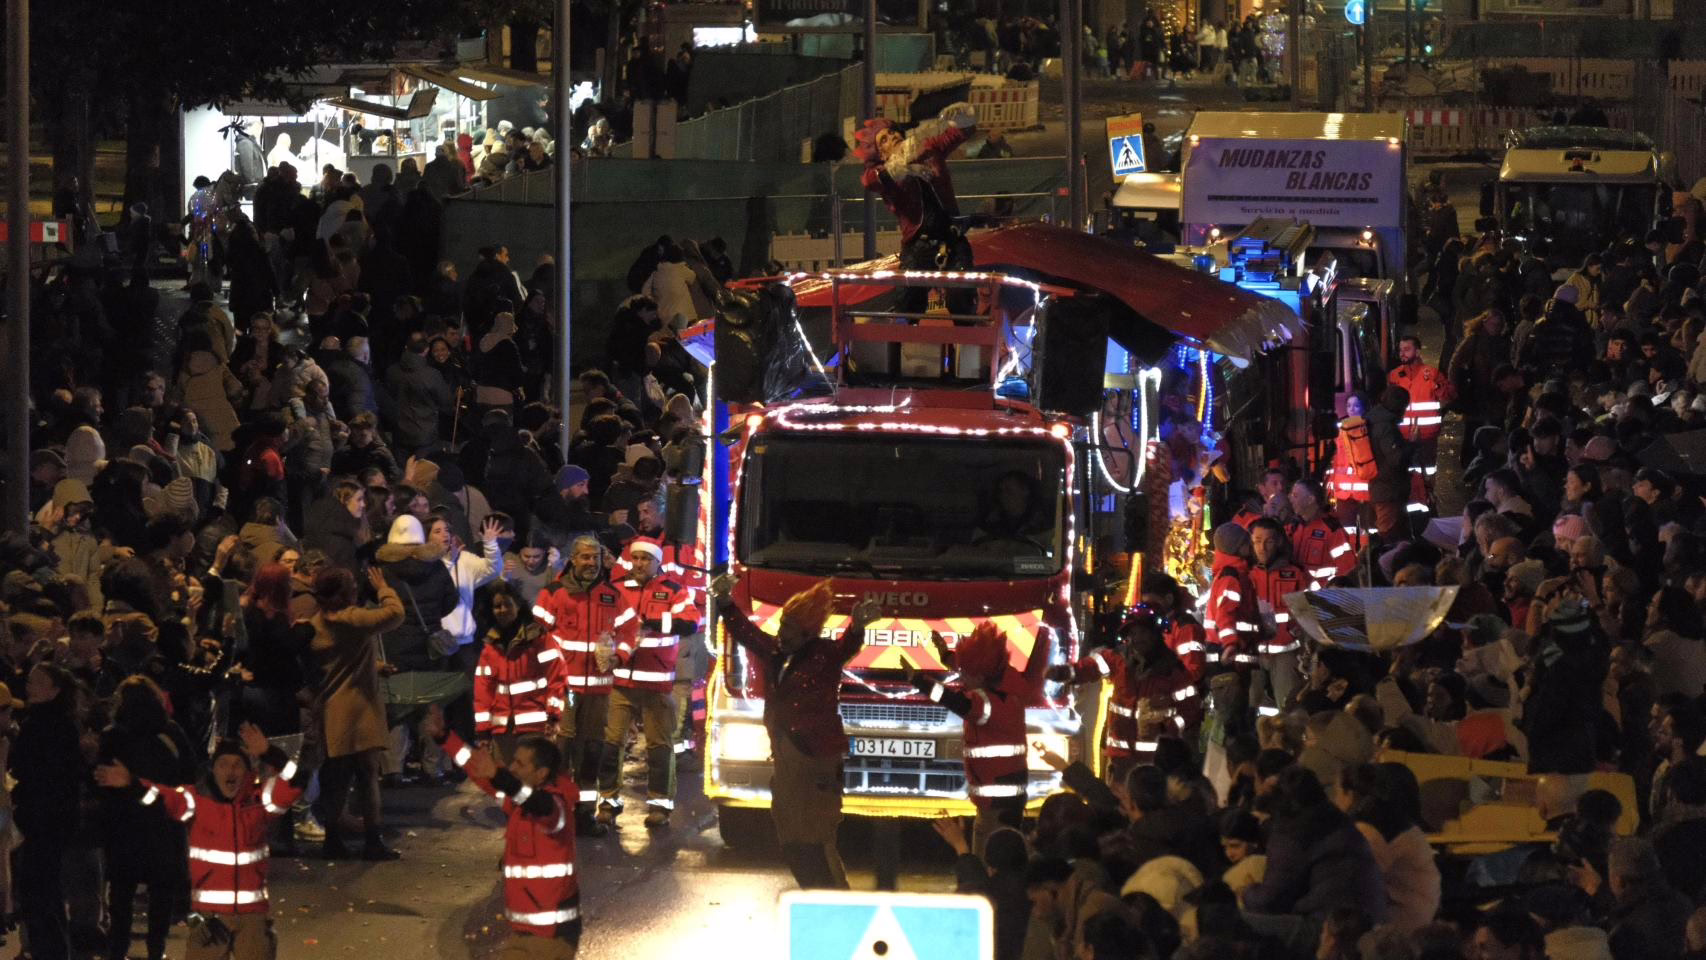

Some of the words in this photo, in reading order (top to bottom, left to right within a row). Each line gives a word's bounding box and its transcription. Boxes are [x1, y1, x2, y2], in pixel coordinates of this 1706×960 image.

[1218, 149, 1327, 169] MUDANZAS
[1285, 171, 1373, 191] BLANCAS
[1240, 206, 1285, 214] Servicio
[1299, 207, 1340, 216] medida
[864, 592, 929, 606] IVECO
[856, 739, 897, 755] 0314
[903, 741, 933, 756] DTZ
